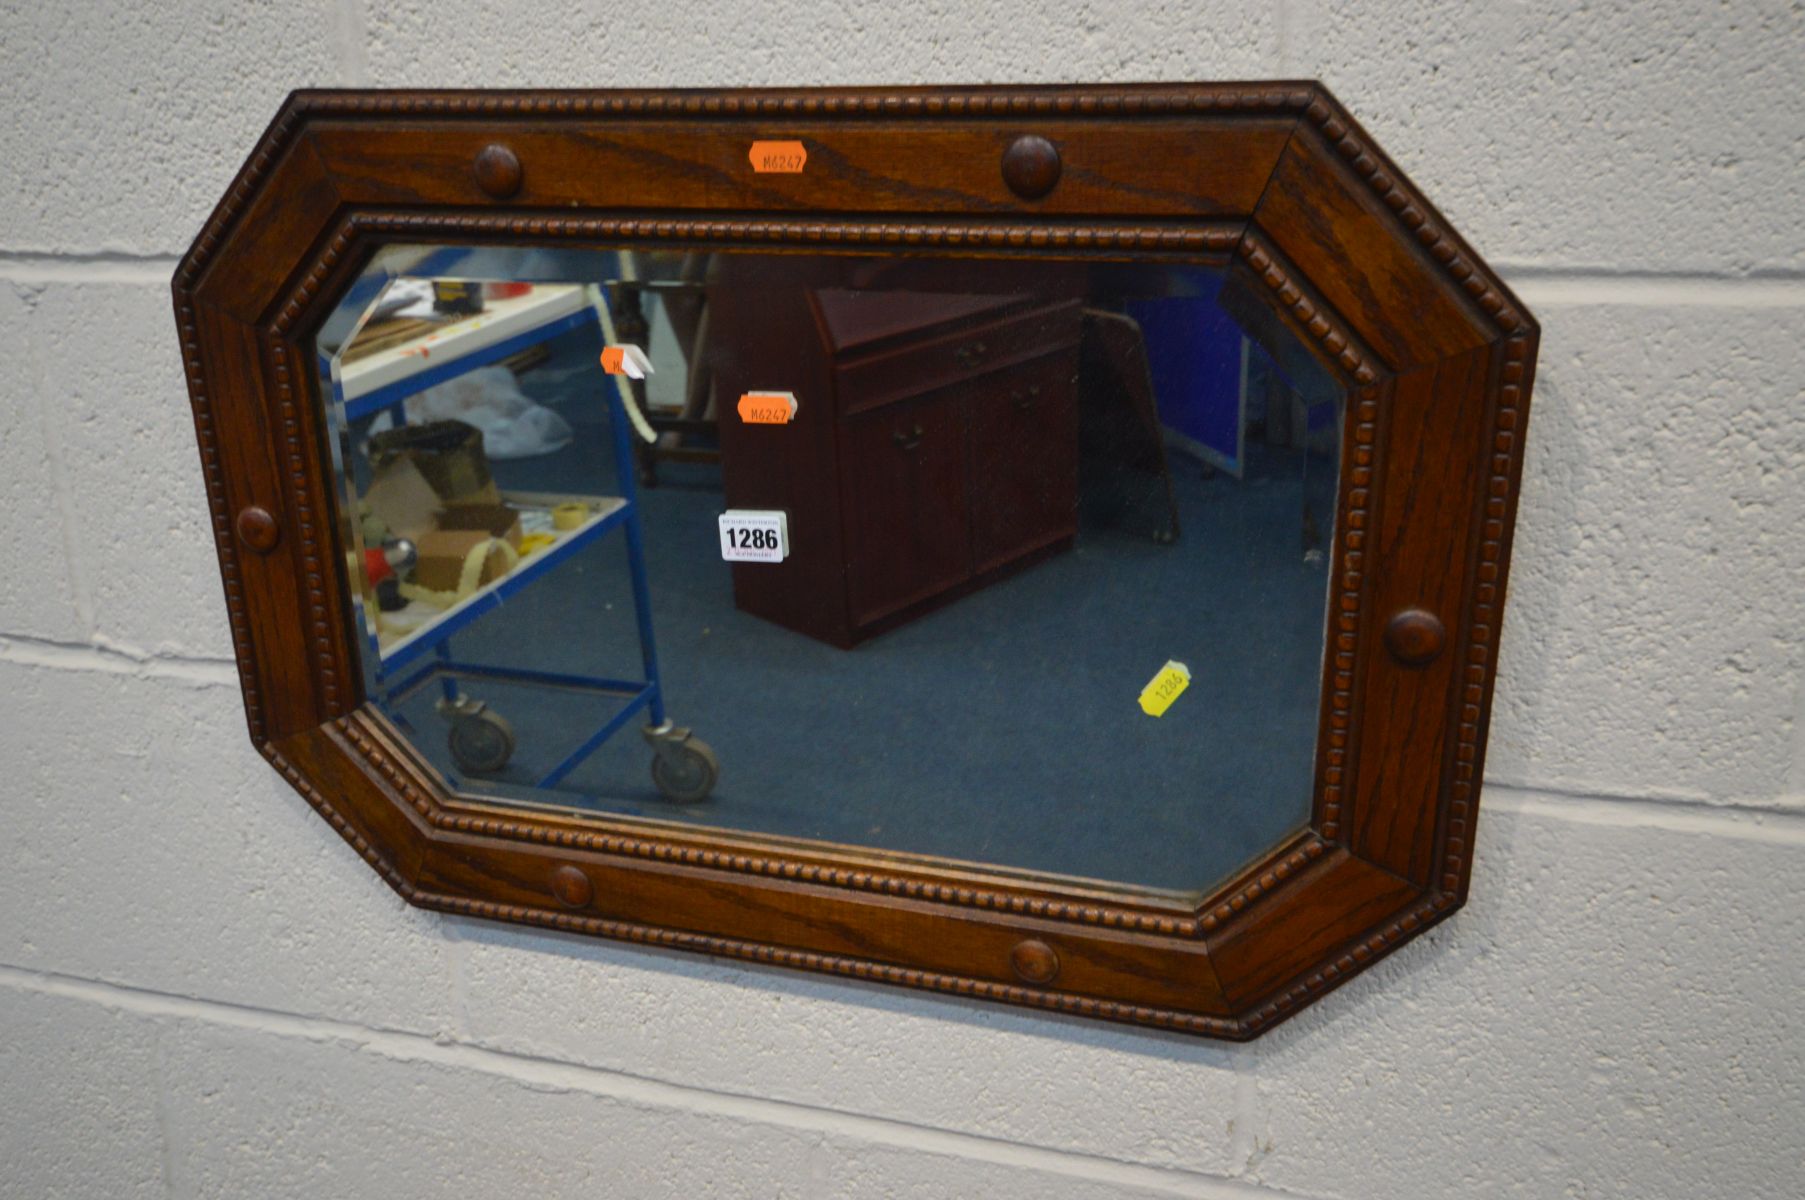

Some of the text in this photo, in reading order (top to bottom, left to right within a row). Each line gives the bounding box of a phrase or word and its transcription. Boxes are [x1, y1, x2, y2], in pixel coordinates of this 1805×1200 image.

[751, 407, 787, 422] M6247
[727, 527, 779, 550] 1286
[1155, 672, 1183, 700] 1286
